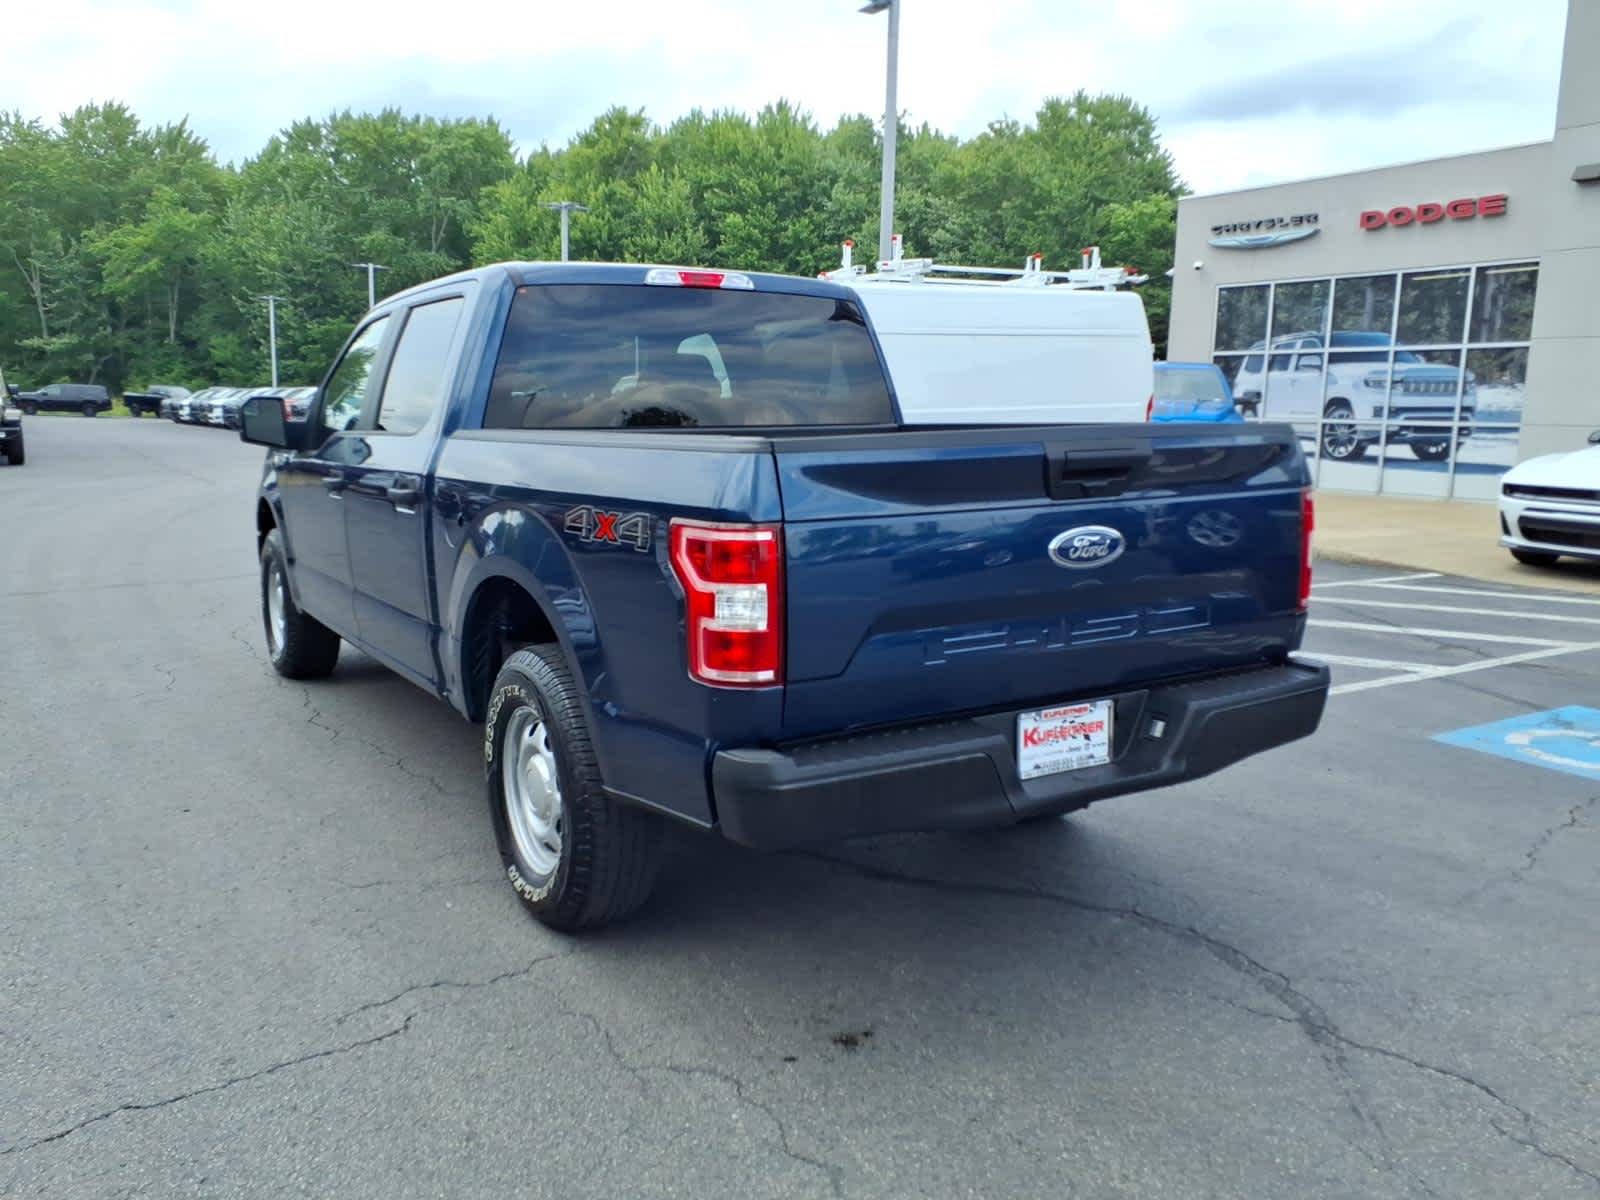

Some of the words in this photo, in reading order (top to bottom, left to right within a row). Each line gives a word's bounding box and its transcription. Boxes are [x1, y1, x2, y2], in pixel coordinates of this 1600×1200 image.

[1210, 213, 1319, 235] CHRYSLER
[1360, 193, 1508, 231] DODGE
[912, 604, 1211, 666] F-150
